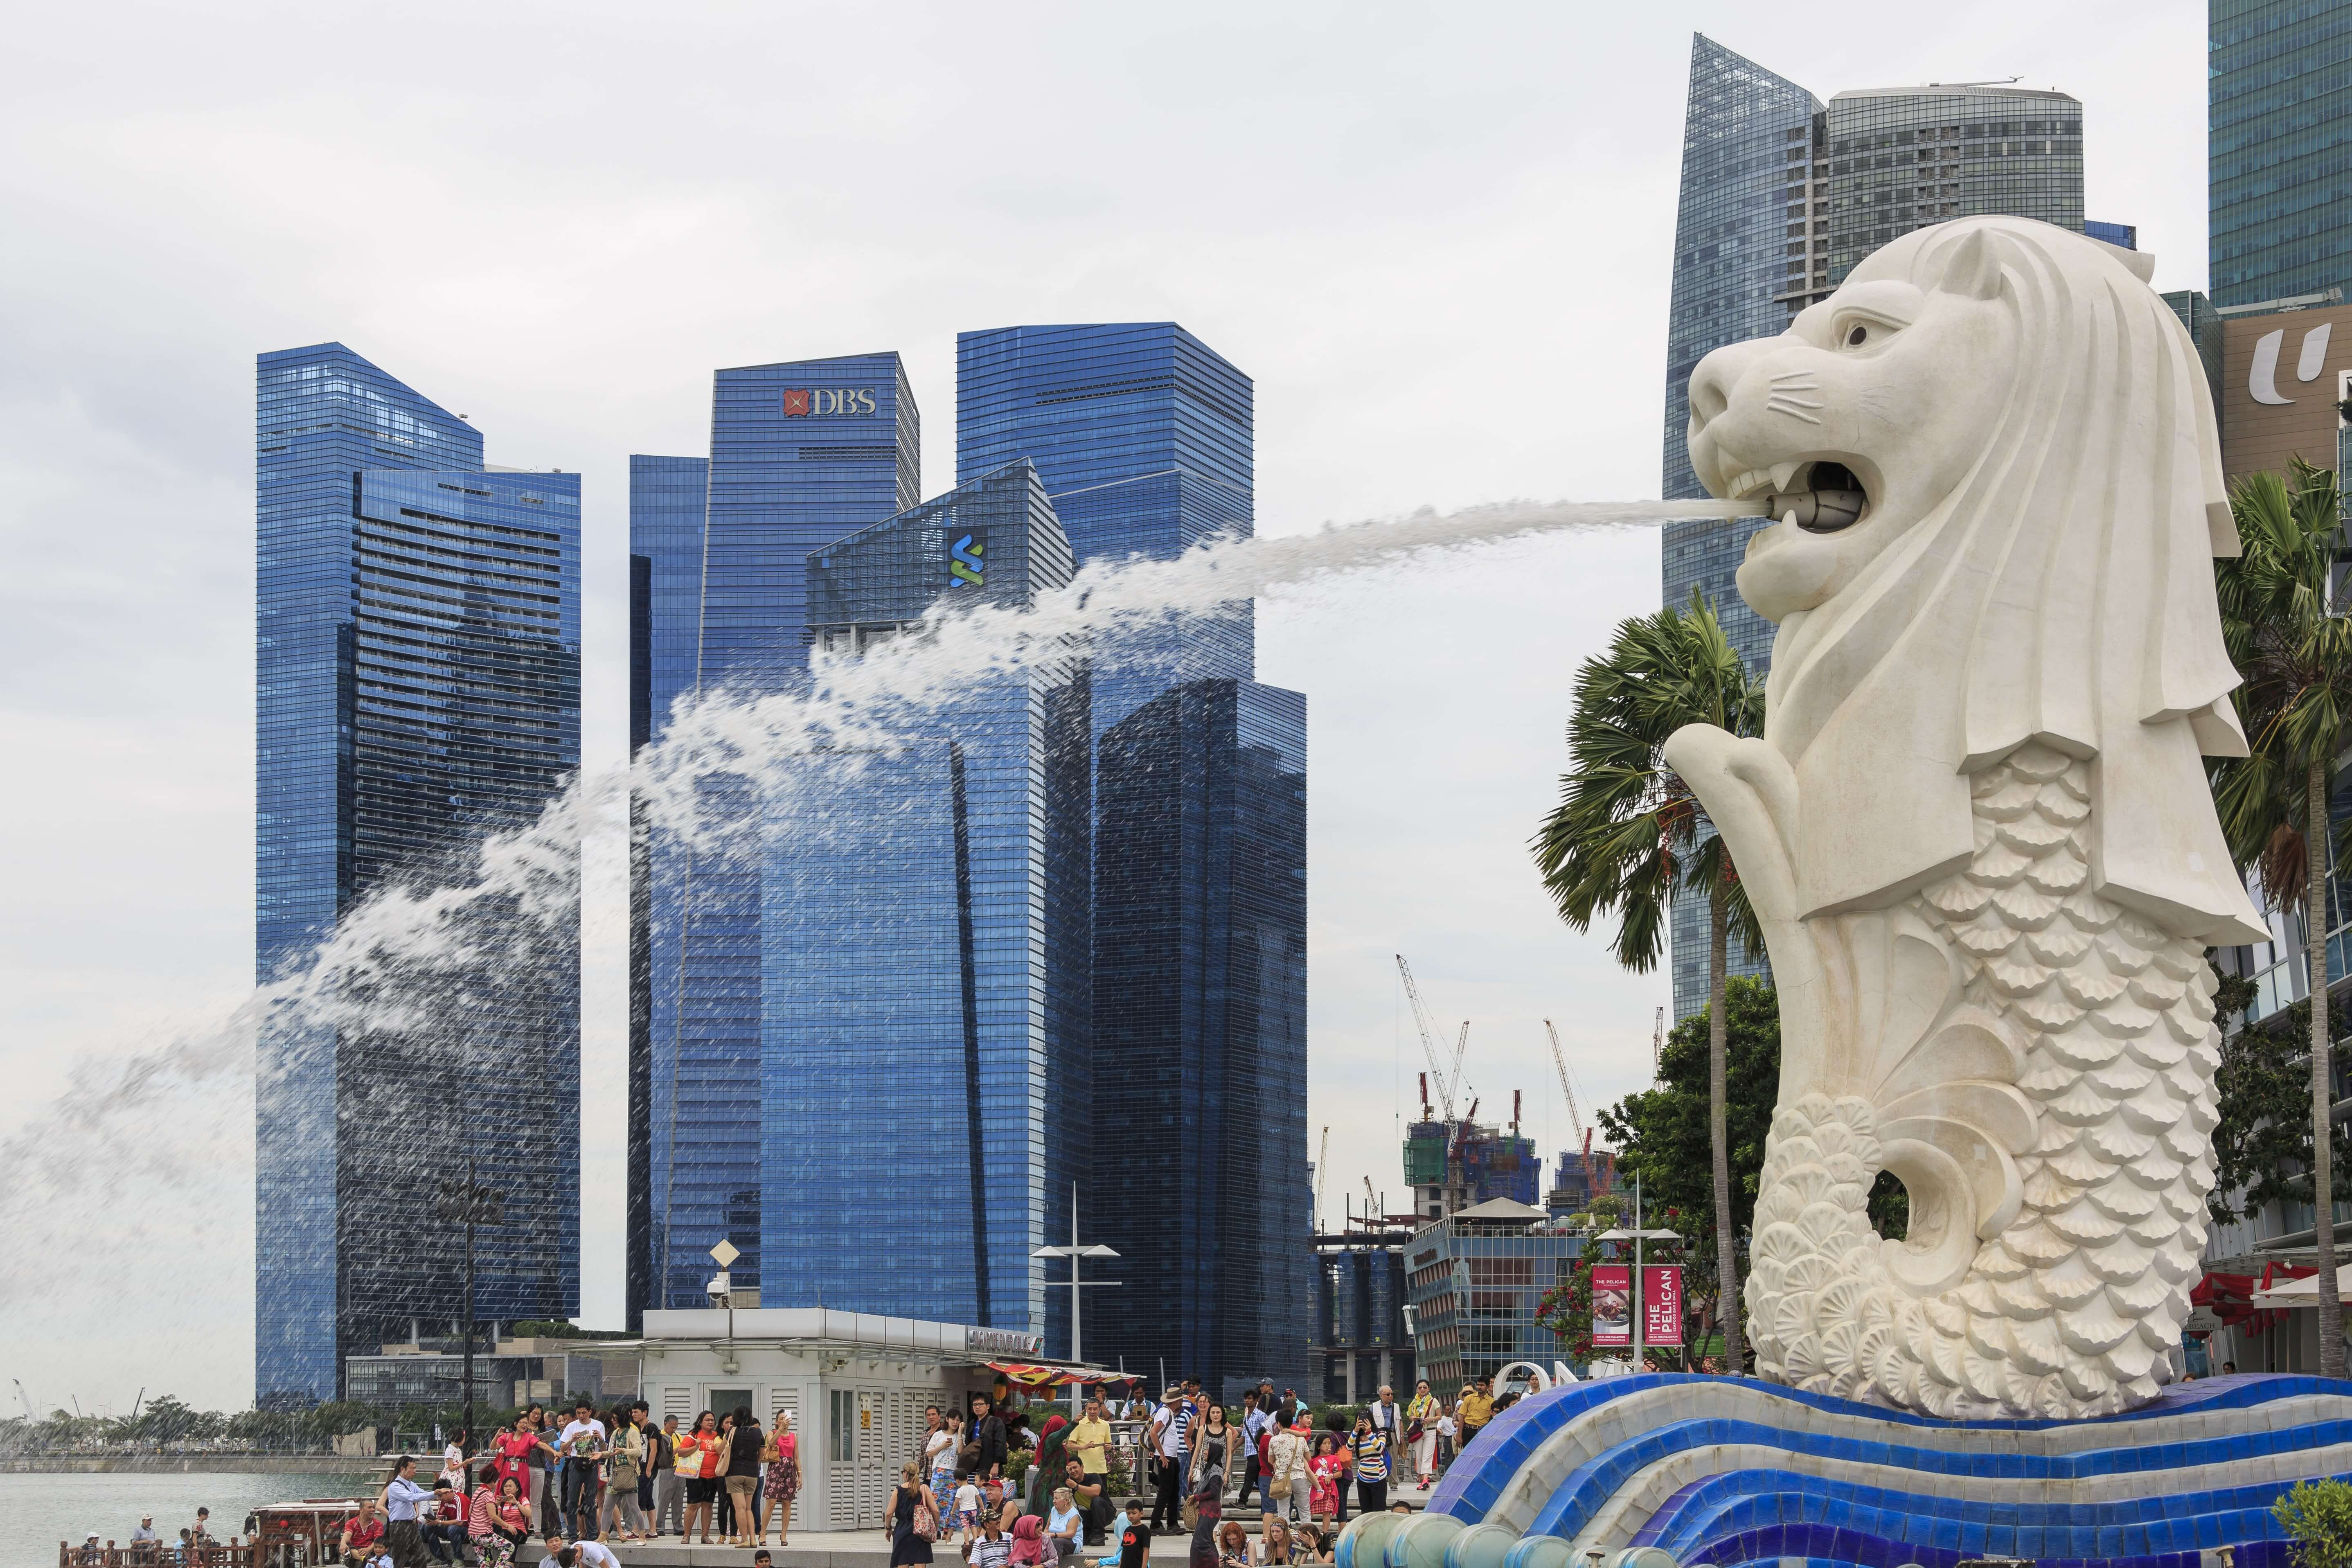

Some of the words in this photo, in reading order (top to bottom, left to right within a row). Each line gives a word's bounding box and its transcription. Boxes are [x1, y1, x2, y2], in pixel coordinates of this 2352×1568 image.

[814, 389, 876, 415] DBS
[1661, 1271, 1672, 1333] PELICAN
[1649, 1304, 1660, 1333] THE
[970, 1330, 999, 1349] SINGAPORE
[1000, 1334, 1013, 1351] RIVER
[1014, 1335, 1030, 1352] CRUISE
